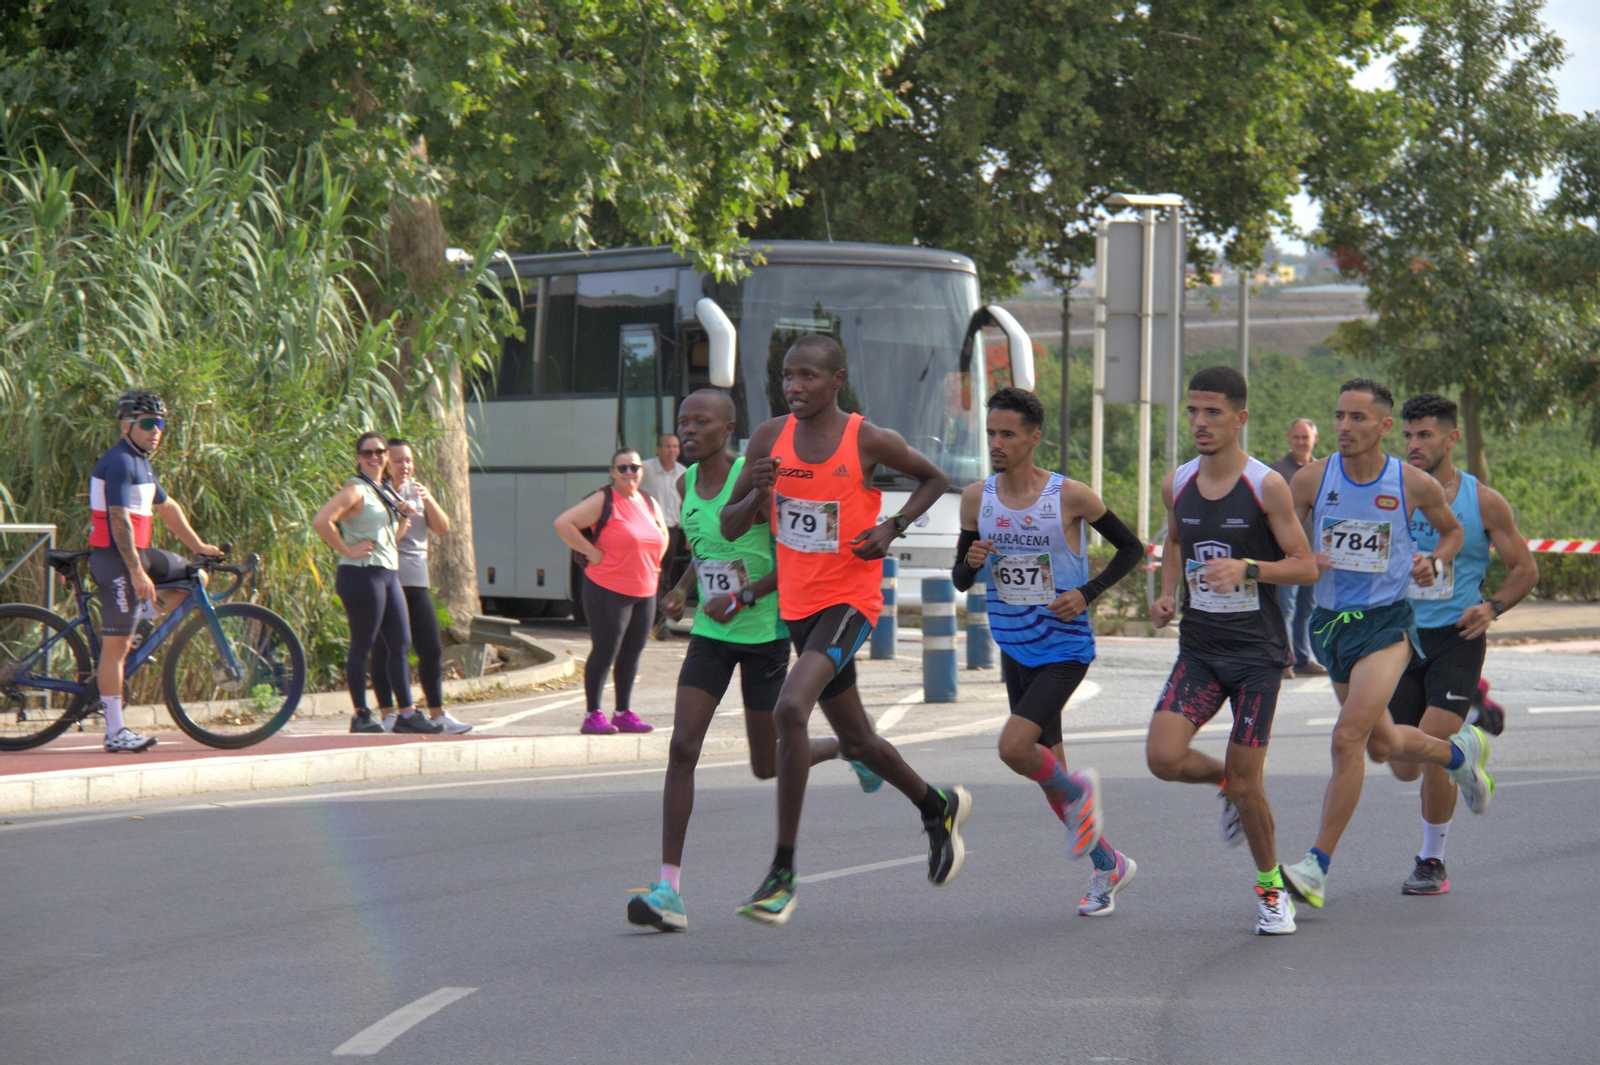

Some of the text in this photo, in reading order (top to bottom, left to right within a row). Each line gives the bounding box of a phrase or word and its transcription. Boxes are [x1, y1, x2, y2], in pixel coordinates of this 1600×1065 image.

[788, 510, 816, 533] 79
[988, 533, 1050, 546] MARACENA
[1333, 531, 1378, 552] 784
[704, 573, 730, 590] 78
[1000, 567, 1039, 585] 637
